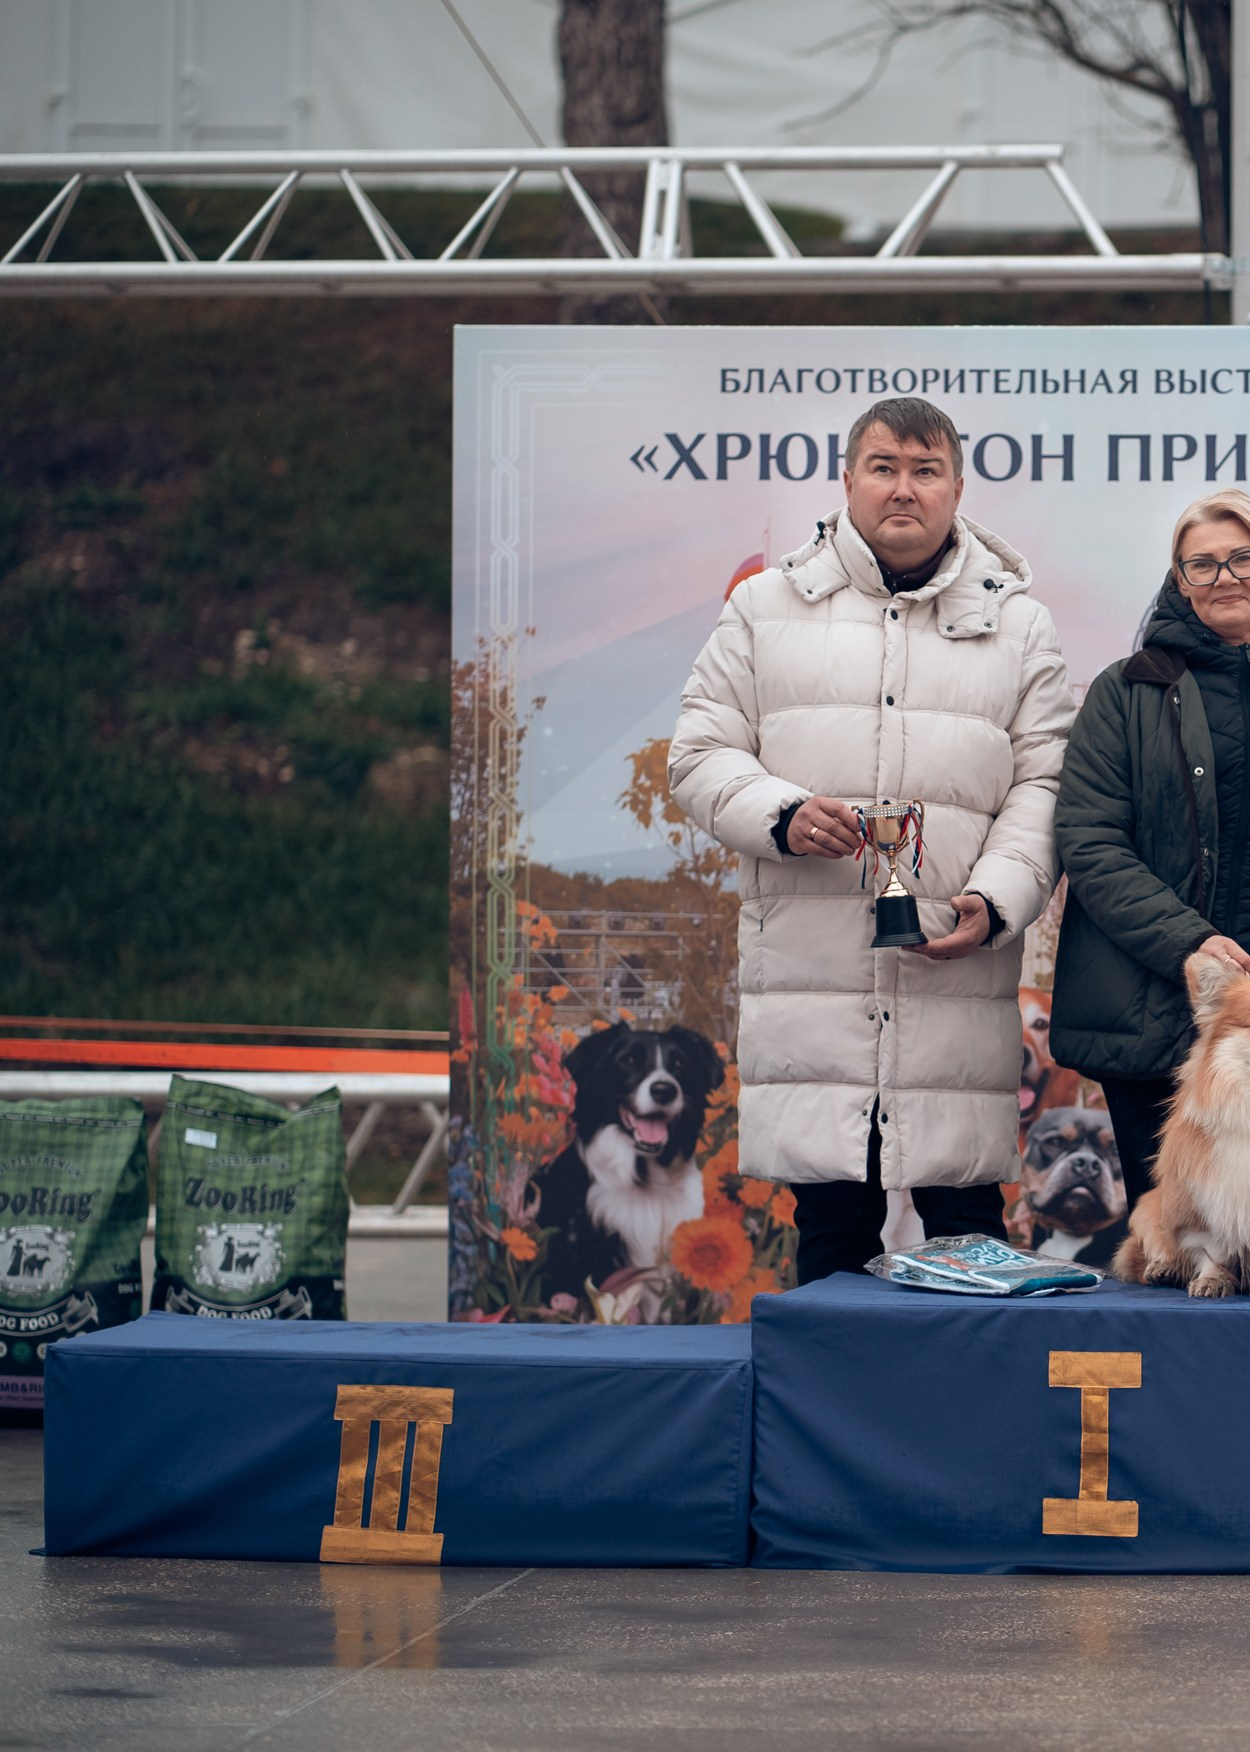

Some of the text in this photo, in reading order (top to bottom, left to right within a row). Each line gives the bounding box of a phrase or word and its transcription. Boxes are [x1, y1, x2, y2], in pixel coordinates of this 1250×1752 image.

[720, 368, 1137, 395] БЛАГОТВОРИТЕЛЬНАЯ
[629, 432, 1075, 482] «ХРЮОН
[0, 1186, 94, 1223] ooRing
[185, 1177, 299, 1217] ZooRing
[0, 1312, 59, 1331] OG FOOD
[1041, 1351, 1144, 1538] I
